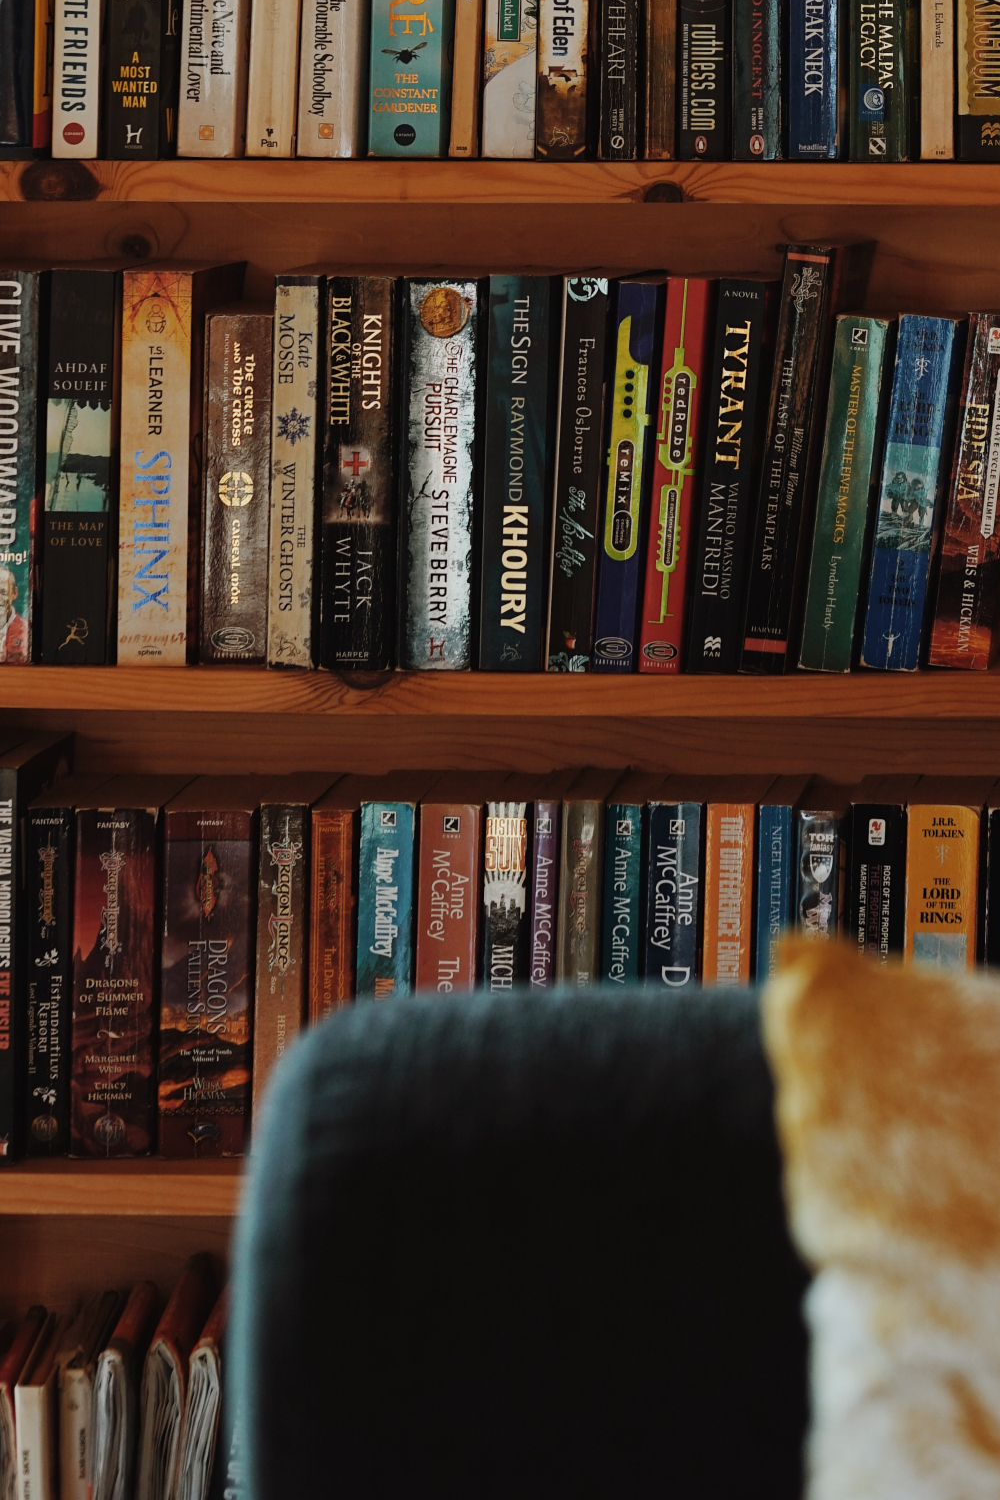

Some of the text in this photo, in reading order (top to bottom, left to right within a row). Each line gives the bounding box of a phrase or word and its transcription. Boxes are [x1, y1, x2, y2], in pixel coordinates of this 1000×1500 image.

[132, 52, 139, 63] A
[61, 23, 89, 113] FRIENDS
[120, 66, 150, 79] MOST
[804, 46, 823, 95] NECK
[395, 73, 419, 84] THE
[112, 81, 158, 93] WANTED
[374, 88, 438, 99] CONSTANT
[123, 95, 146, 108] MAN
[373, 102, 438, 113] GARDENER
[55, 362, 107, 374] AHDAF
[53, 380, 107, 391] SOUEIF
[714, 321, 751, 471] TYRANT
[500, 396, 529, 634] RAYMOND KHOURY
[51, 522, 104, 531] THE MAP
[133, 450, 172, 613] SPHINX
[51, 538, 102, 546] OF LOVE
[932, 818, 956, 826] J.R.R.
[922, 829, 964, 838] TOLKIEN
[922, 888, 961, 901] LORD
[941, 901, 956, 909] THE
[609, 848, 632, 983] Anne McCaffrey
[919, 911, 963, 924] RINGS
